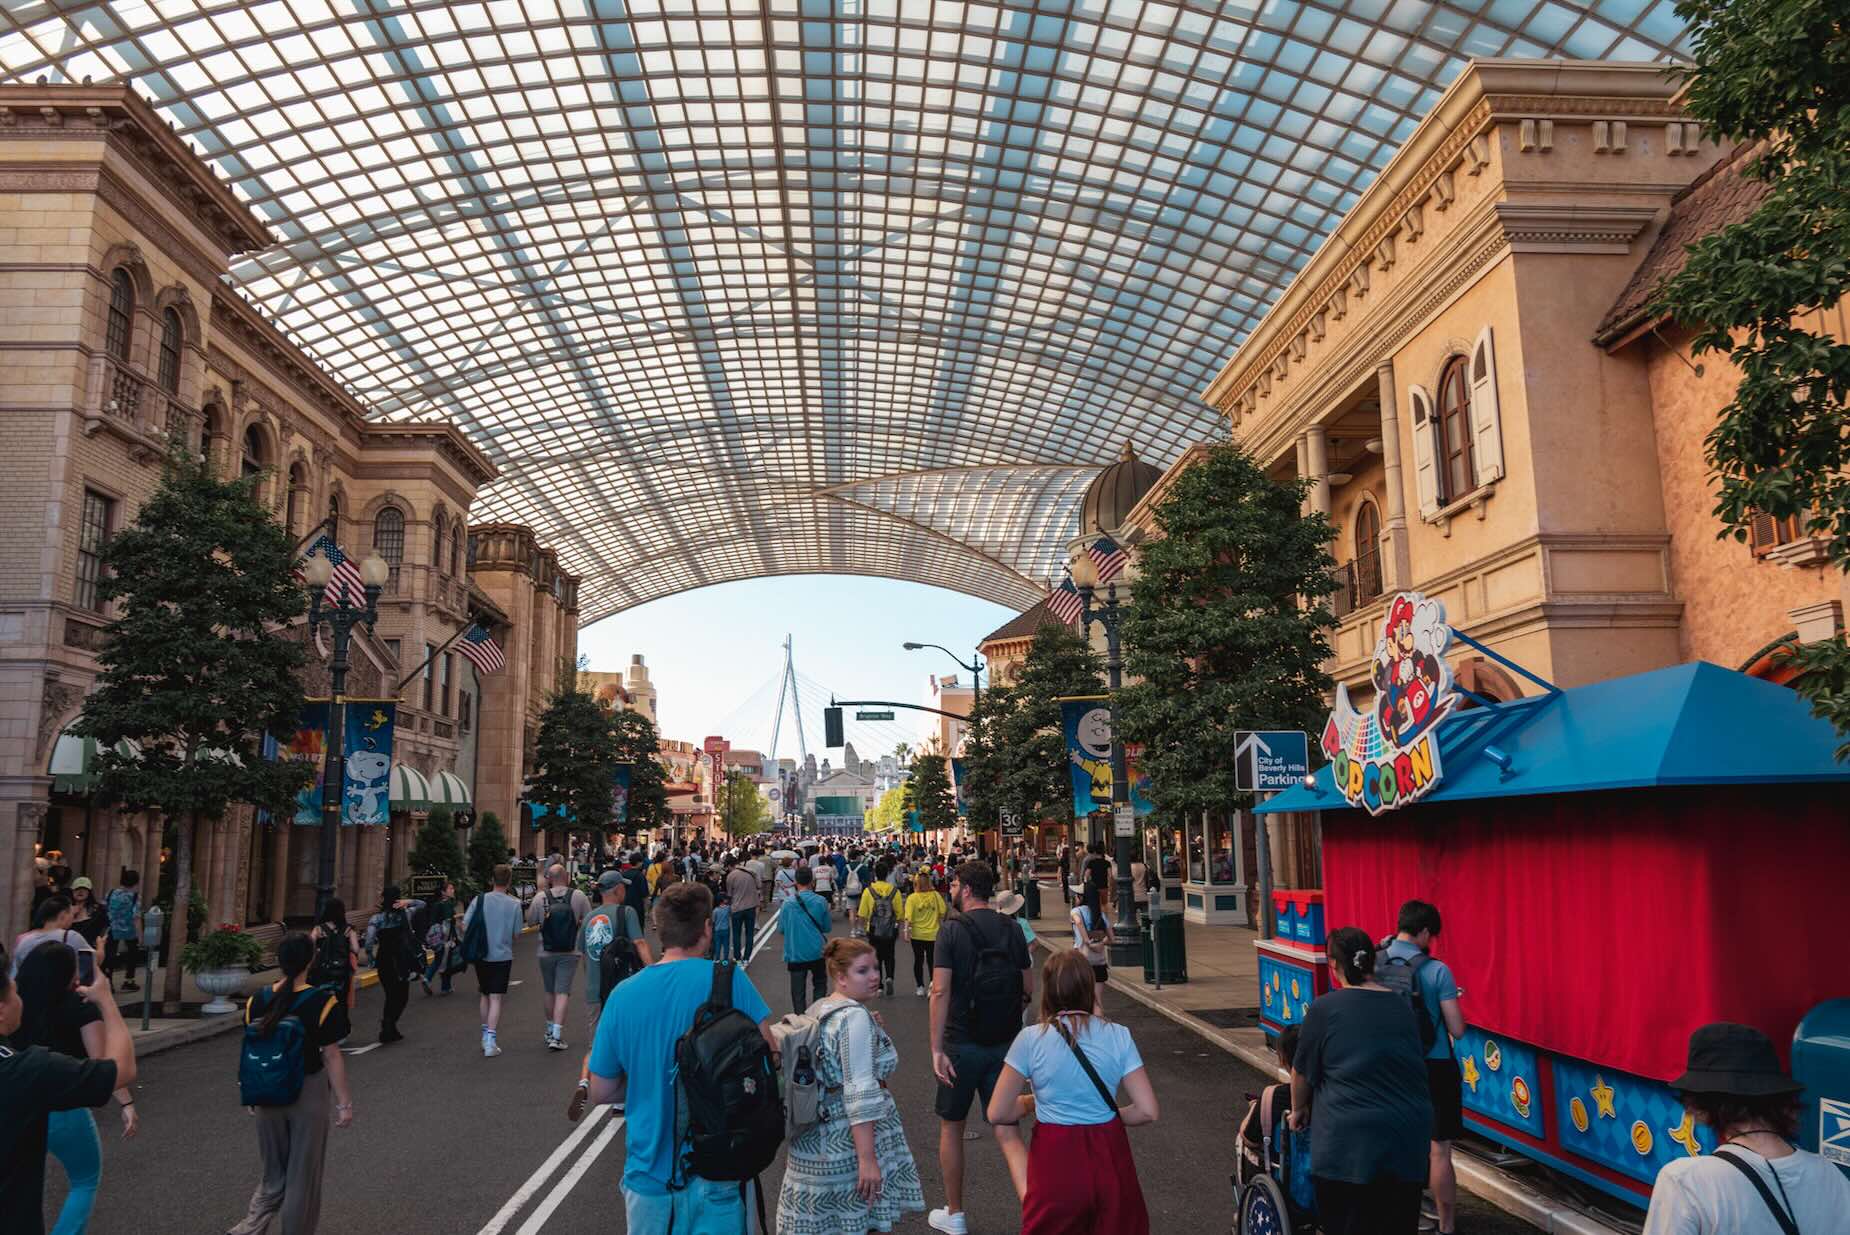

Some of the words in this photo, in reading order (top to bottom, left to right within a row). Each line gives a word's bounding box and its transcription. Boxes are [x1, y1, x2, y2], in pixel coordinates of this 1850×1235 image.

[1258, 757, 1273, 765] City
[1274, 757, 1283, 765] of
[1322, 717, 1434, 811] POPCORN
[1258, 764, 1287, 773] Beverly
[1288, 764, 1305, 772] Hills
